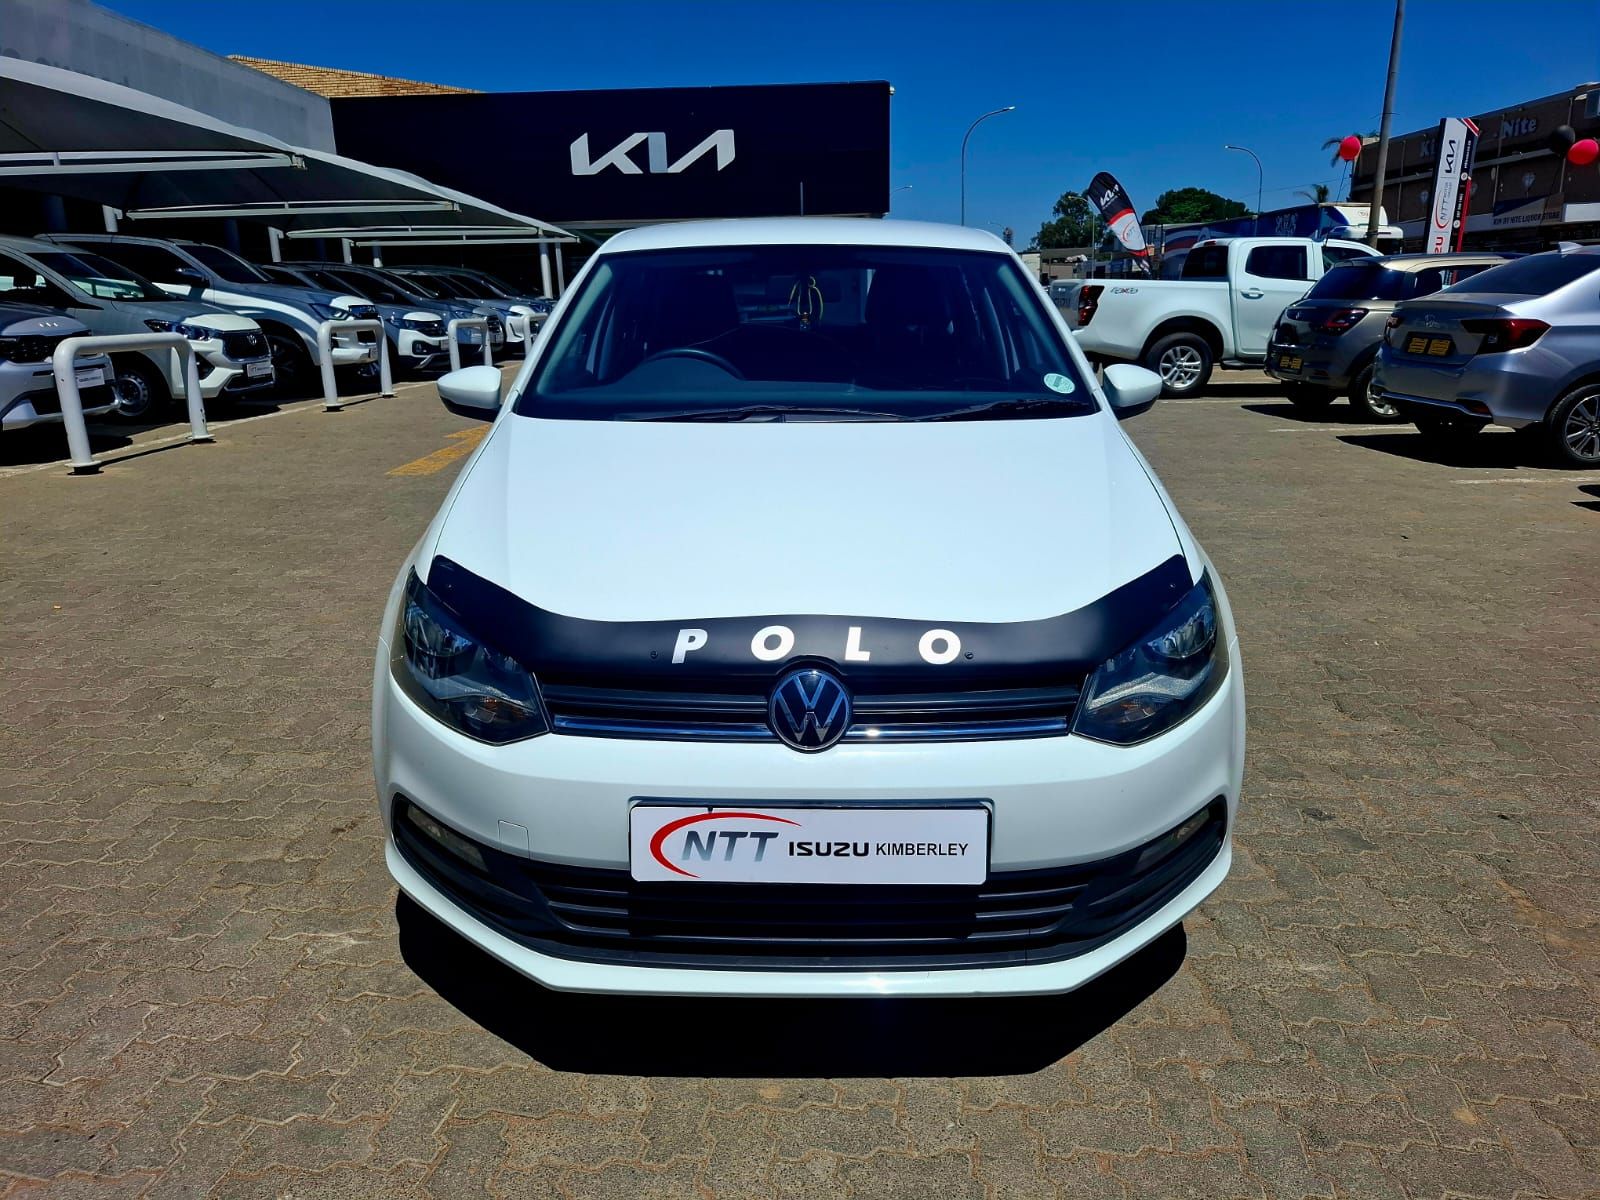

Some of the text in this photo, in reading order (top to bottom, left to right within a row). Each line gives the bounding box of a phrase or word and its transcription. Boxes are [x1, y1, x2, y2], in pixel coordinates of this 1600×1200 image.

[1501, 118, 1537, 139] Nite
[570, 129, 736, 175] KIA
[672, 625, 961, 664] POLO
[681, 831, 969, 862] NTT ISUZU KIMBERLEY
